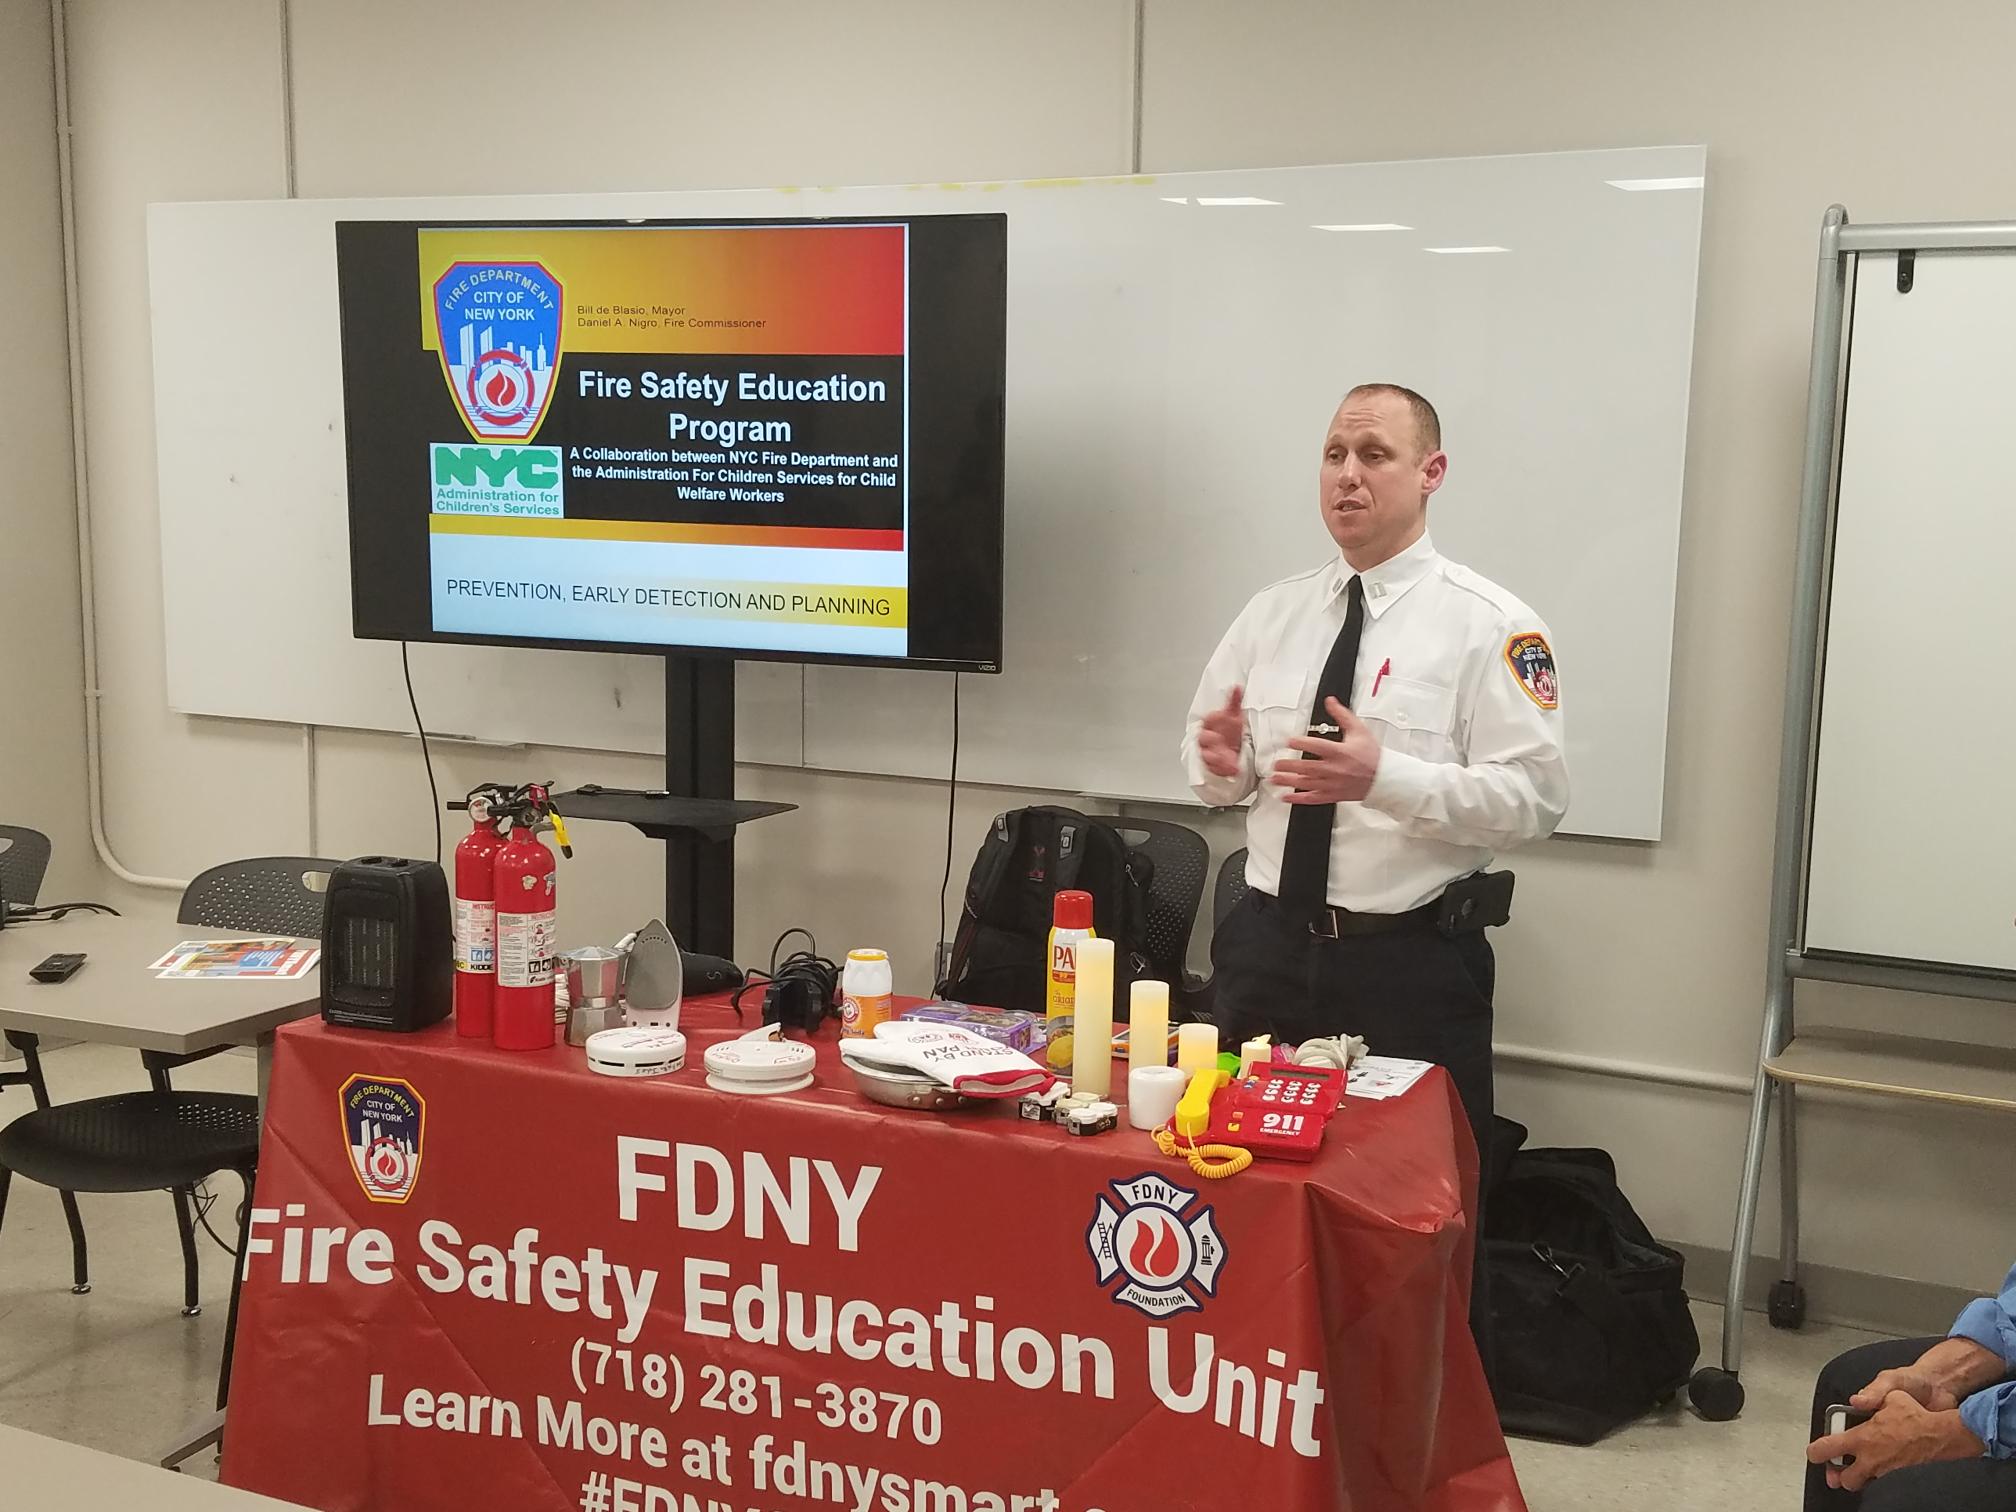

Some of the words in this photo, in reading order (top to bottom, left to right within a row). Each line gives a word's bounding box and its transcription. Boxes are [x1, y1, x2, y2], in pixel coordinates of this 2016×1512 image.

[445, 280, 469, 310] FIRE
[470, 269, 554, 309] DEPARTMENT
[474, 291, 503, 303] CITY
[507, 291, 524, 303] OF
[465, 308, 494, 320] NEW
[498, 309, 535, 321] YORK
[577, 305, 593, 315] Bill
[596, 305, 610, 315] de
[652, 306, 686, 317] Mayor
[577, 318, 611, 327] Daniel
[664, 318, 685, 328] Fire
[688, 318, 767, 328] Commissioner
[579, 370, 632, 398] Fire
[640, 371, 729, 407] Safety
[738, 372, 886, 402] Education
[669, 413, 791, 448] Program
[435, 446, 559, 489] NYC
[569, 446, 580, 459] A
[582, 447, 668, 462] Collaboration
[671, 449, 725, 463] between
[729, 450, 758, 465] NYC
[762, 452, 787, 465] Fire
[791, 452, 869, 469] Department
[872, 454, 898, 467] and
[571, 465, 592, 478] the
[595, 465, 689, 481] Administration
[692, 468, 715, 482] For
[717, 469, 773, 483] Children
[776, 470, 834, 485] Services
[837, 472, 858, 486] for
[860, 472, 896, 487] Child
[437, 488, 536, 502] Administration
[540, 491, 559, 503] for
[677, 486, 727, 501] Welfare
[729, 487, 785, 502] Workers
[436, 501, 500, 513] Children's
[503, 503, 560, 516] Services
[446, 579, 566, 604] PREVENTION,
[572, 585, 630, 604] EARLY
[635, 588, 742, 610] DETECTION
[746, 594, 786, 612] AND
[792, 595, 891, 616] PLANNING
[1053, 944, 1076, 970] PA
[923, 1044, 960, 1060] PAN
[349, 1090, 364, 1109] FIRE
[363, 1085, 415, 1118] DEPARTMENT
[366, 1100, 383, 1109] CITY
[384, 1103, 396, 1111] OF
[362, 1109, 380, 1119] NEW
[380, 1112, 403, 1123] YORK
[1262, 1112, 1305, 1131] 911
[616, 1134, 884, 1253] FDNY
[1131, 1183, 1179, 1205] FDNY
[1126, 1288, 1187, 1308] FOUNDATION
[242, 1203, 395, 1285] Fire
[416, 1218, 659, 1344] Safety
[683, 1255, 1115, 1401] Education
[1147, 1326, 1325, 1459] Unit
[570, 1335, 684, 1415] (718)
[699, 1364, 943, 1447] 281-3870
[366, 1373, 524, 1440] Learn
[536, 1394, 668, 1469] More
[681, 1432, 733, 1487] at
